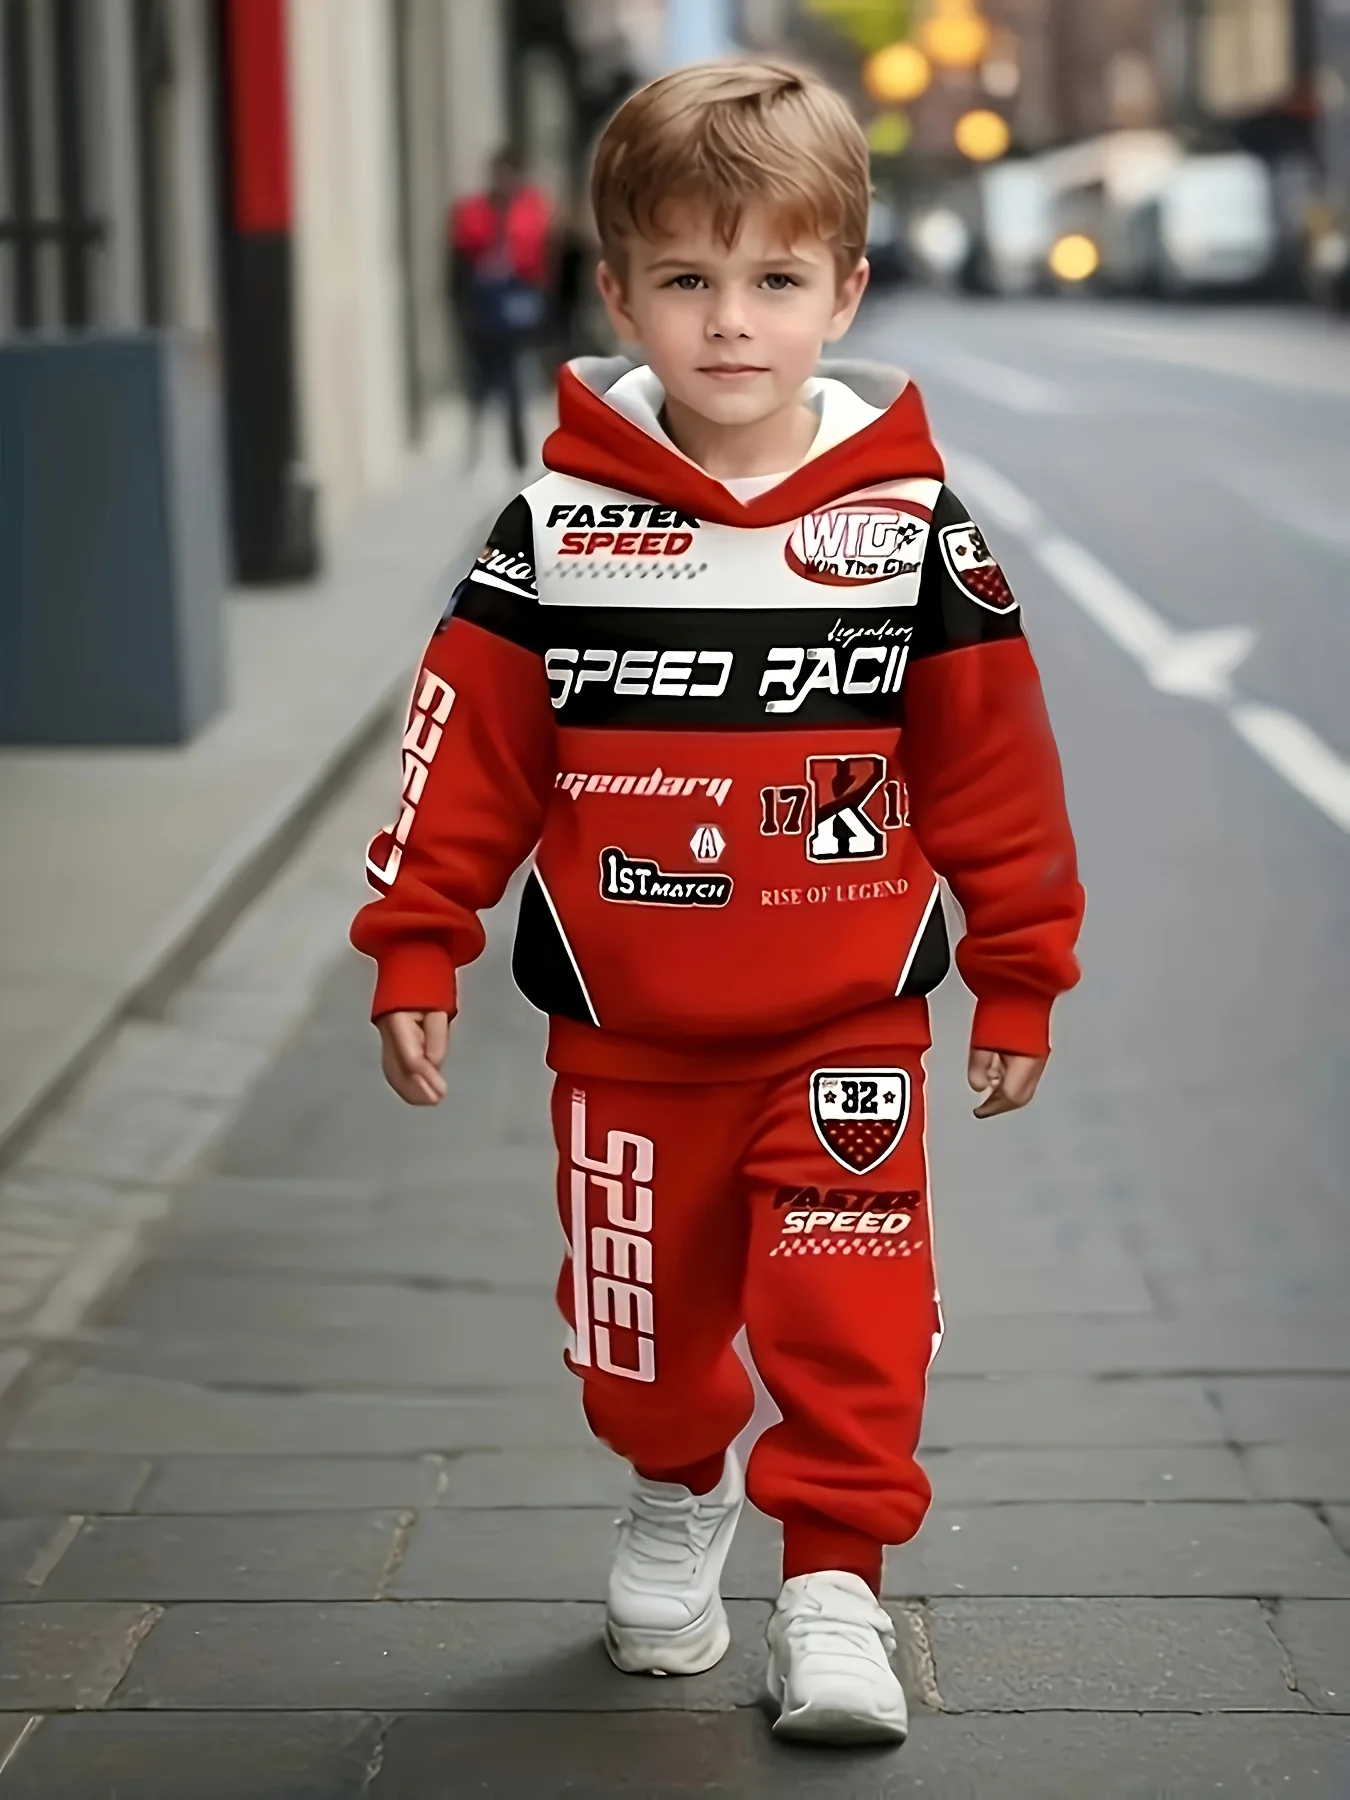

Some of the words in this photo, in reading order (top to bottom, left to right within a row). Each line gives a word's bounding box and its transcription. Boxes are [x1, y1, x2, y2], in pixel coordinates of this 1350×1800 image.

[558, 532, 693, 555] SPEED
[545, 648, 734, 708] SPEED
[554, 767, 733, 807] gendary
[760, 786, 809, 836] 17
[806, 754, 887, 864] K
[761, 889, 802, 905] RISE
[807, 887, 830, 903] OF
[837, 878, 909, 902] LEGEND
[571, 1100, 656, 1382] SPEED
[781, 1211, 911, 1234] SPEED
